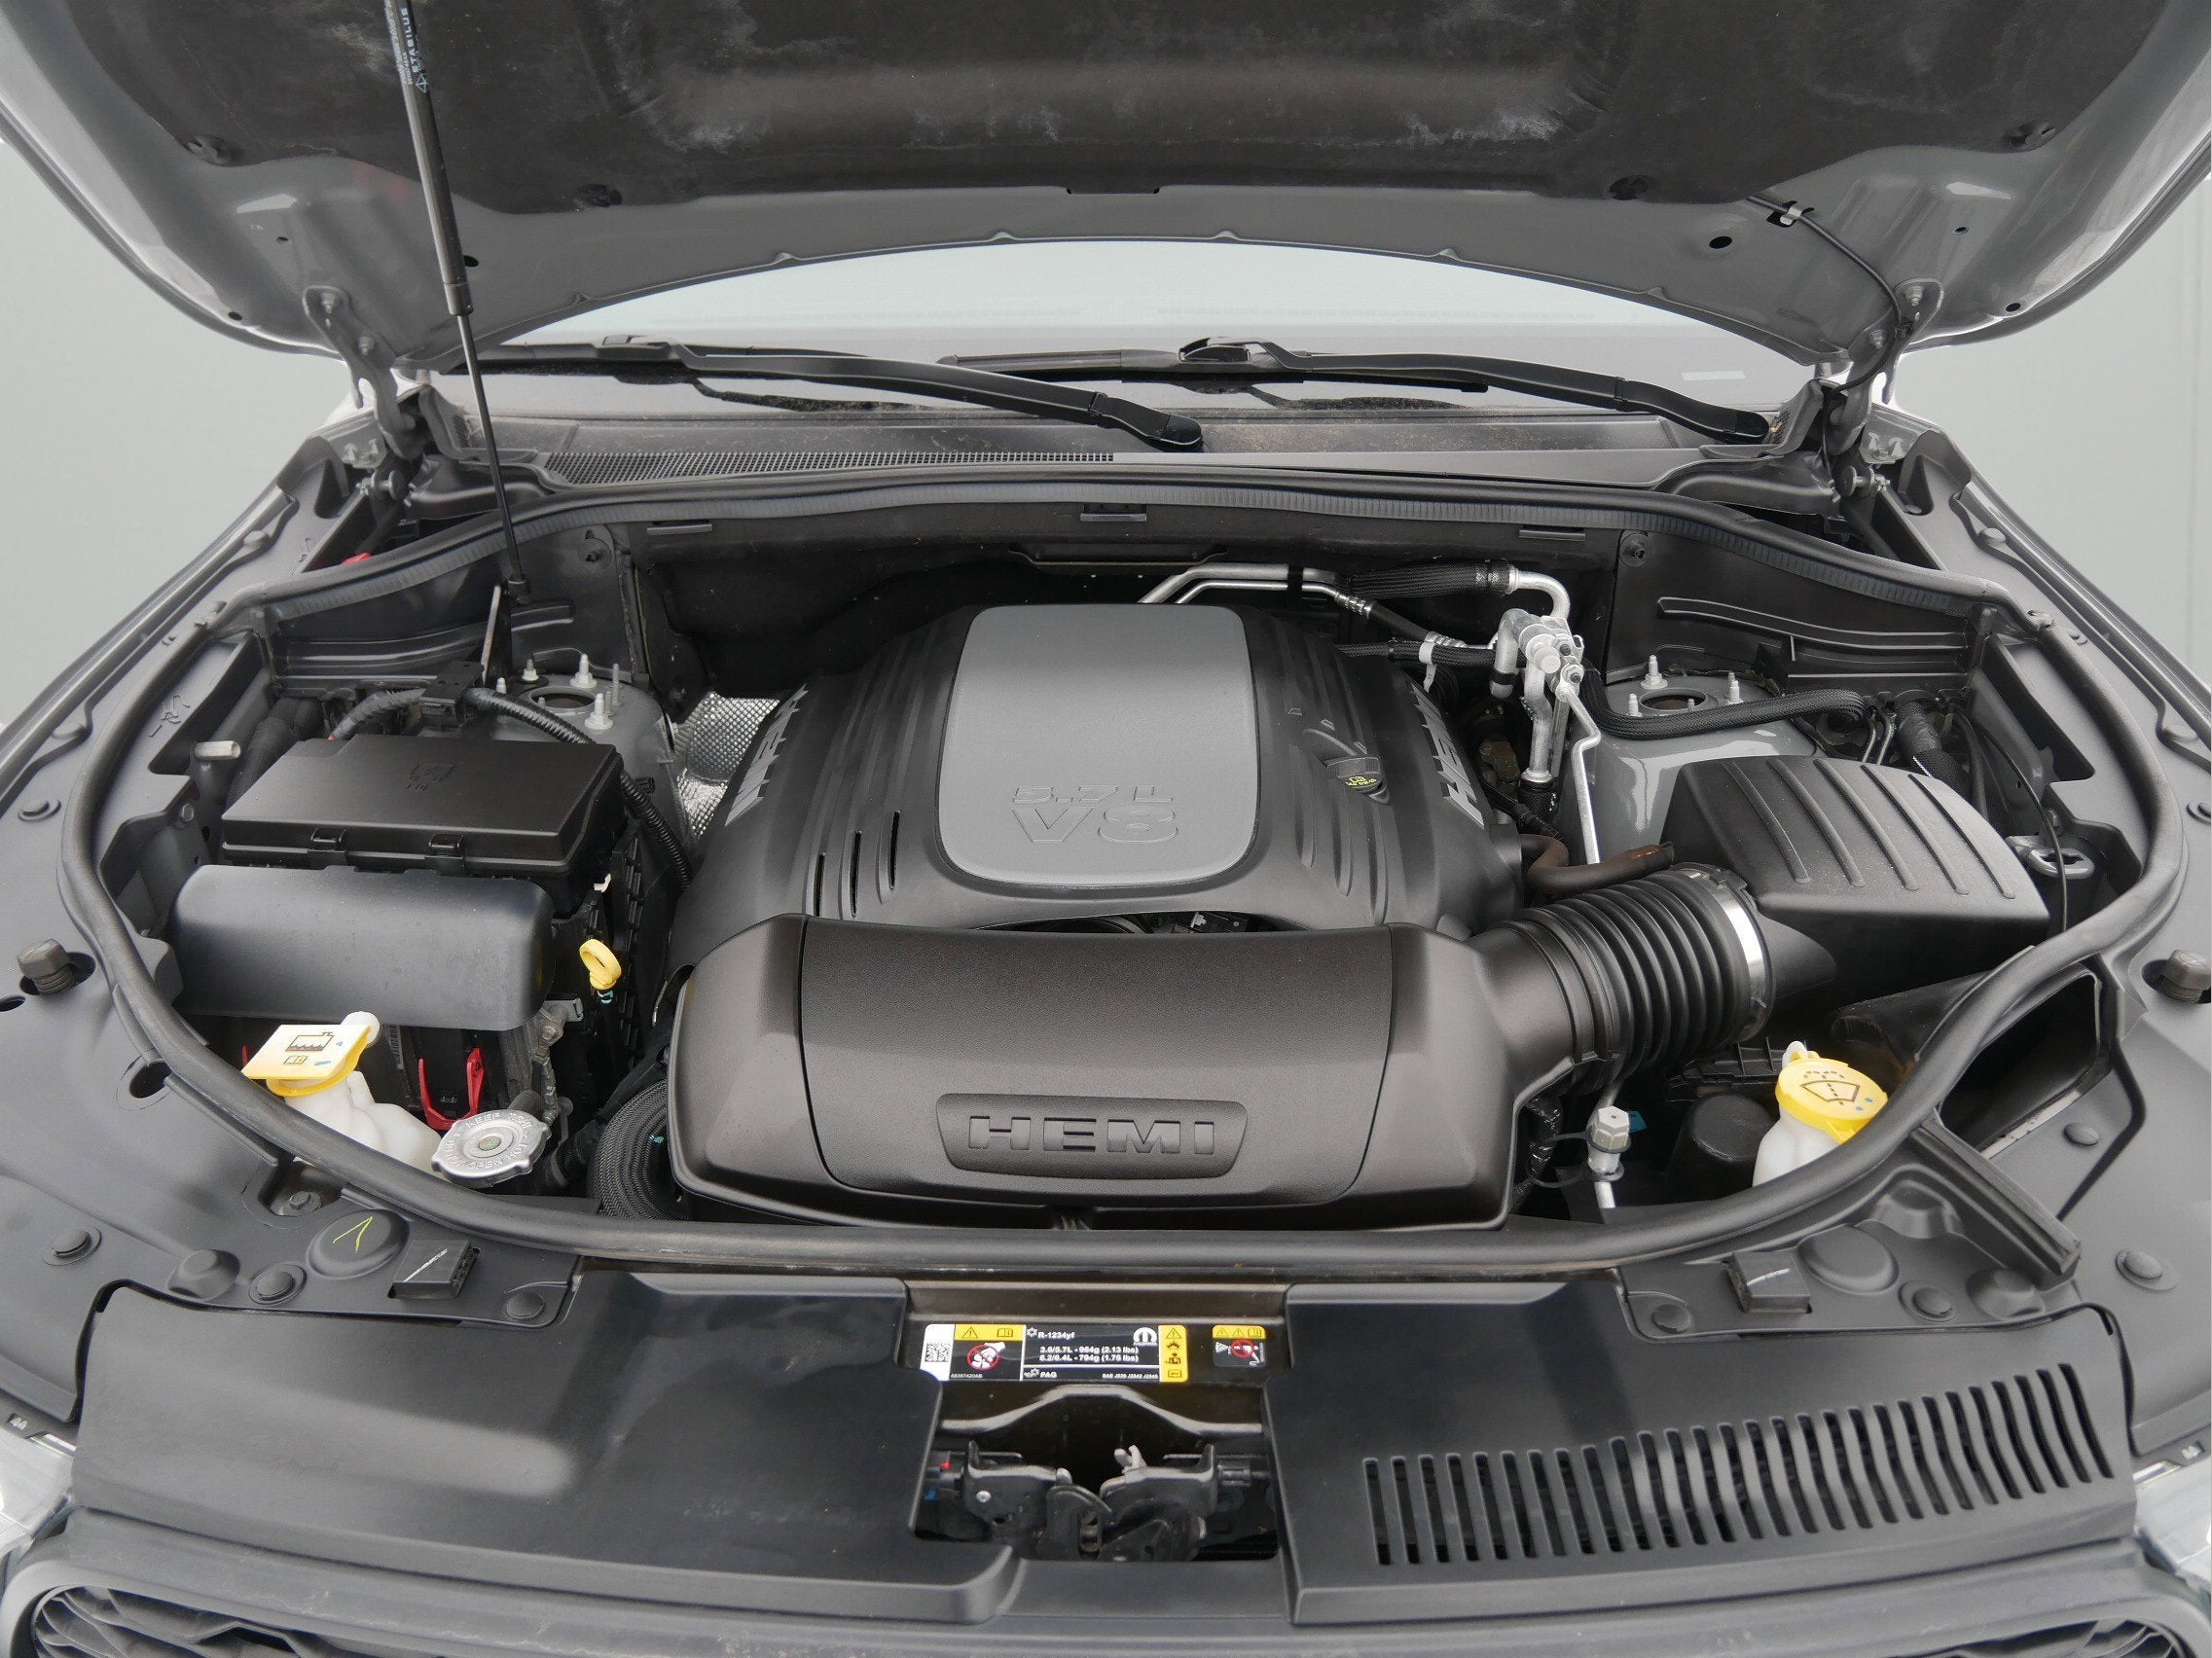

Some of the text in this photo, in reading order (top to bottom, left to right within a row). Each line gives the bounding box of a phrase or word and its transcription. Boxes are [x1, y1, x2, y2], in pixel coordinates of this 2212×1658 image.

[400, 8, 420, 73] STABILUS
[1012, 784, 1174, 804] 5.7L
[1010, 805, 1179, 844] V8
[968, 1115, 1215, 1155] HEMI
[1037, 1331, 1075, 1340] R-1234yf
